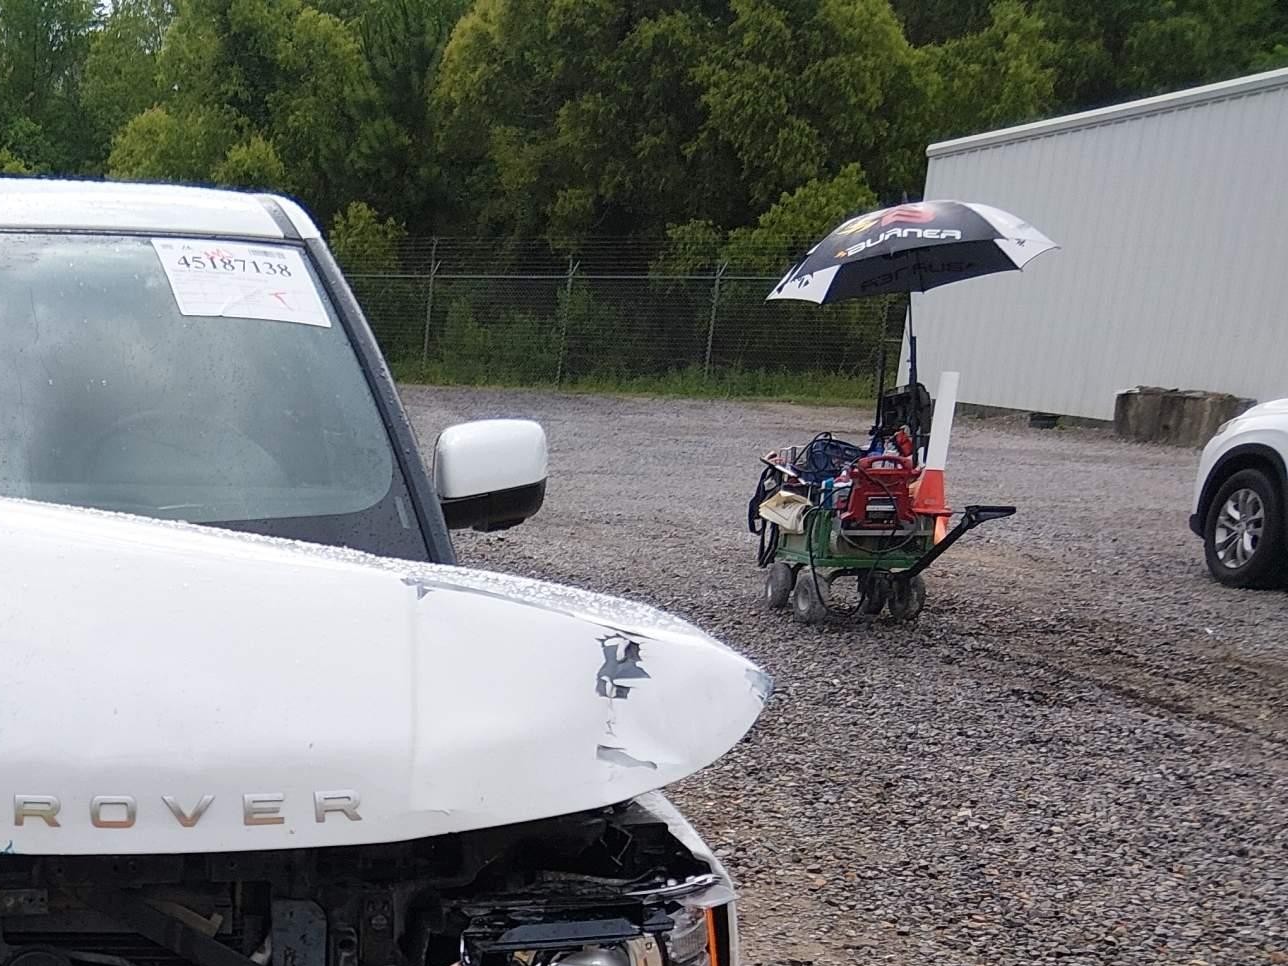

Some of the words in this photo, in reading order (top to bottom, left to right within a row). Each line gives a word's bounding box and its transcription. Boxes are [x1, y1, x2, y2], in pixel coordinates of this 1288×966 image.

[846, 228, 962, 257] BURNER
[177, 255, 292, 277] 45187138
[14, 789, 363, 828] ROVER
